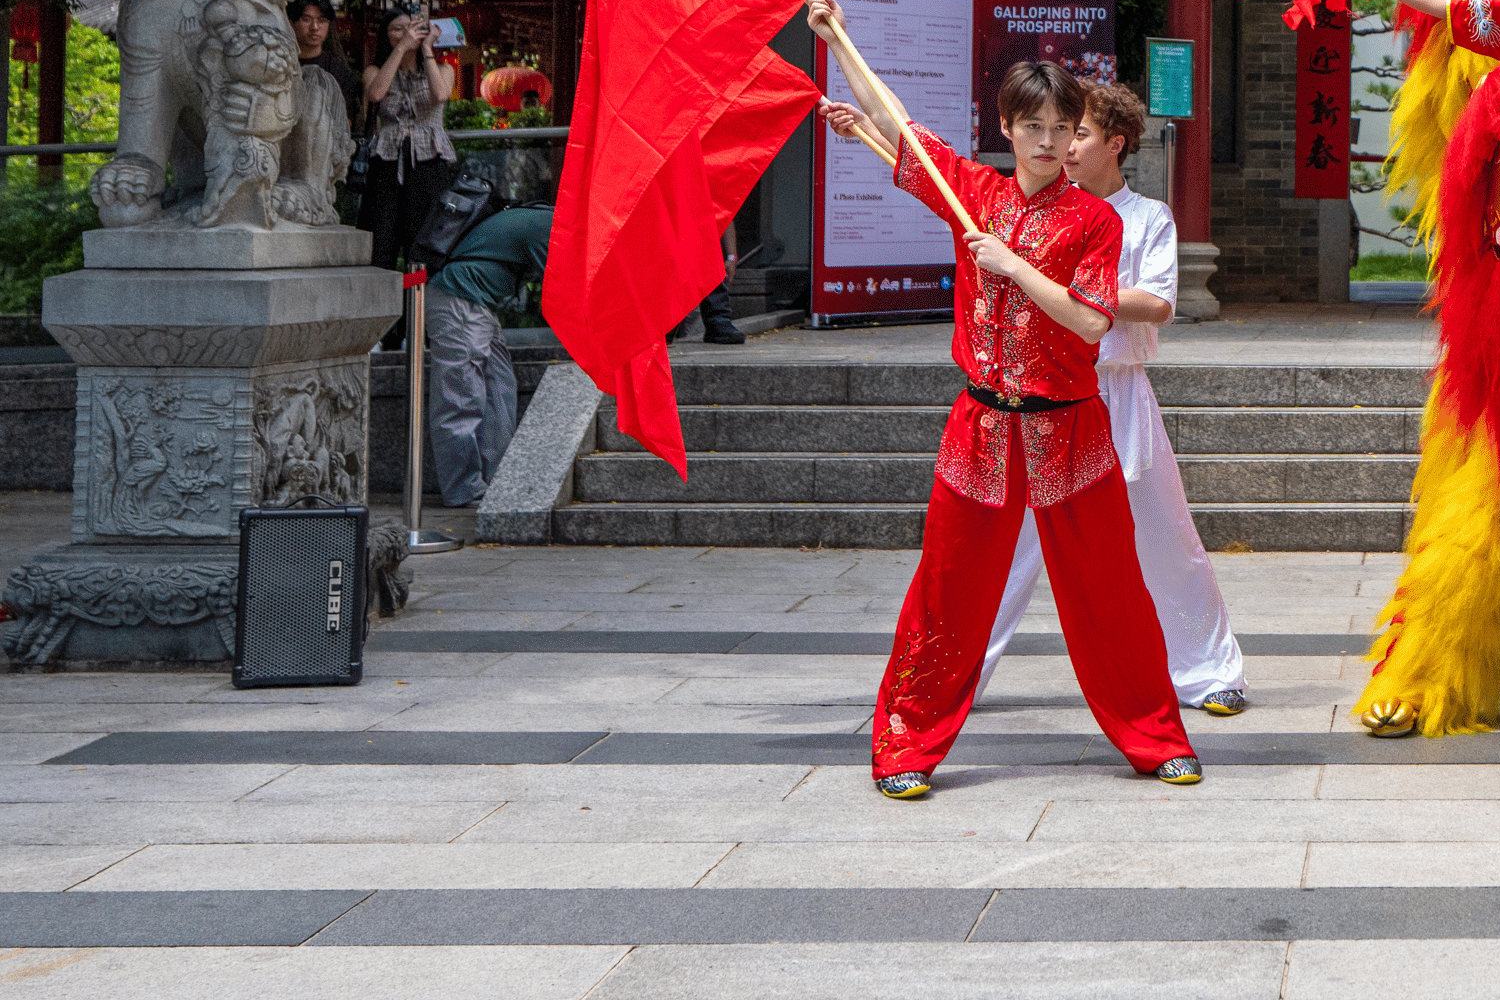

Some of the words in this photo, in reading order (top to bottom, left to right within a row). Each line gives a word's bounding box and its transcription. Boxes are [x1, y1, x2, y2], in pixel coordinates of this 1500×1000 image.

[993, 6, 1071, 19] GALLOPING
[1075, 7, 1107, 20] INTO
[1007, 20, 1093, 34] PROSPERITY
[892, 68, 914, 78] Heritage
[915, 69, 945, 79] Experiences
[856, 193, 883, 201] Exhibition
[327, 560, 343, 632] CUBE
